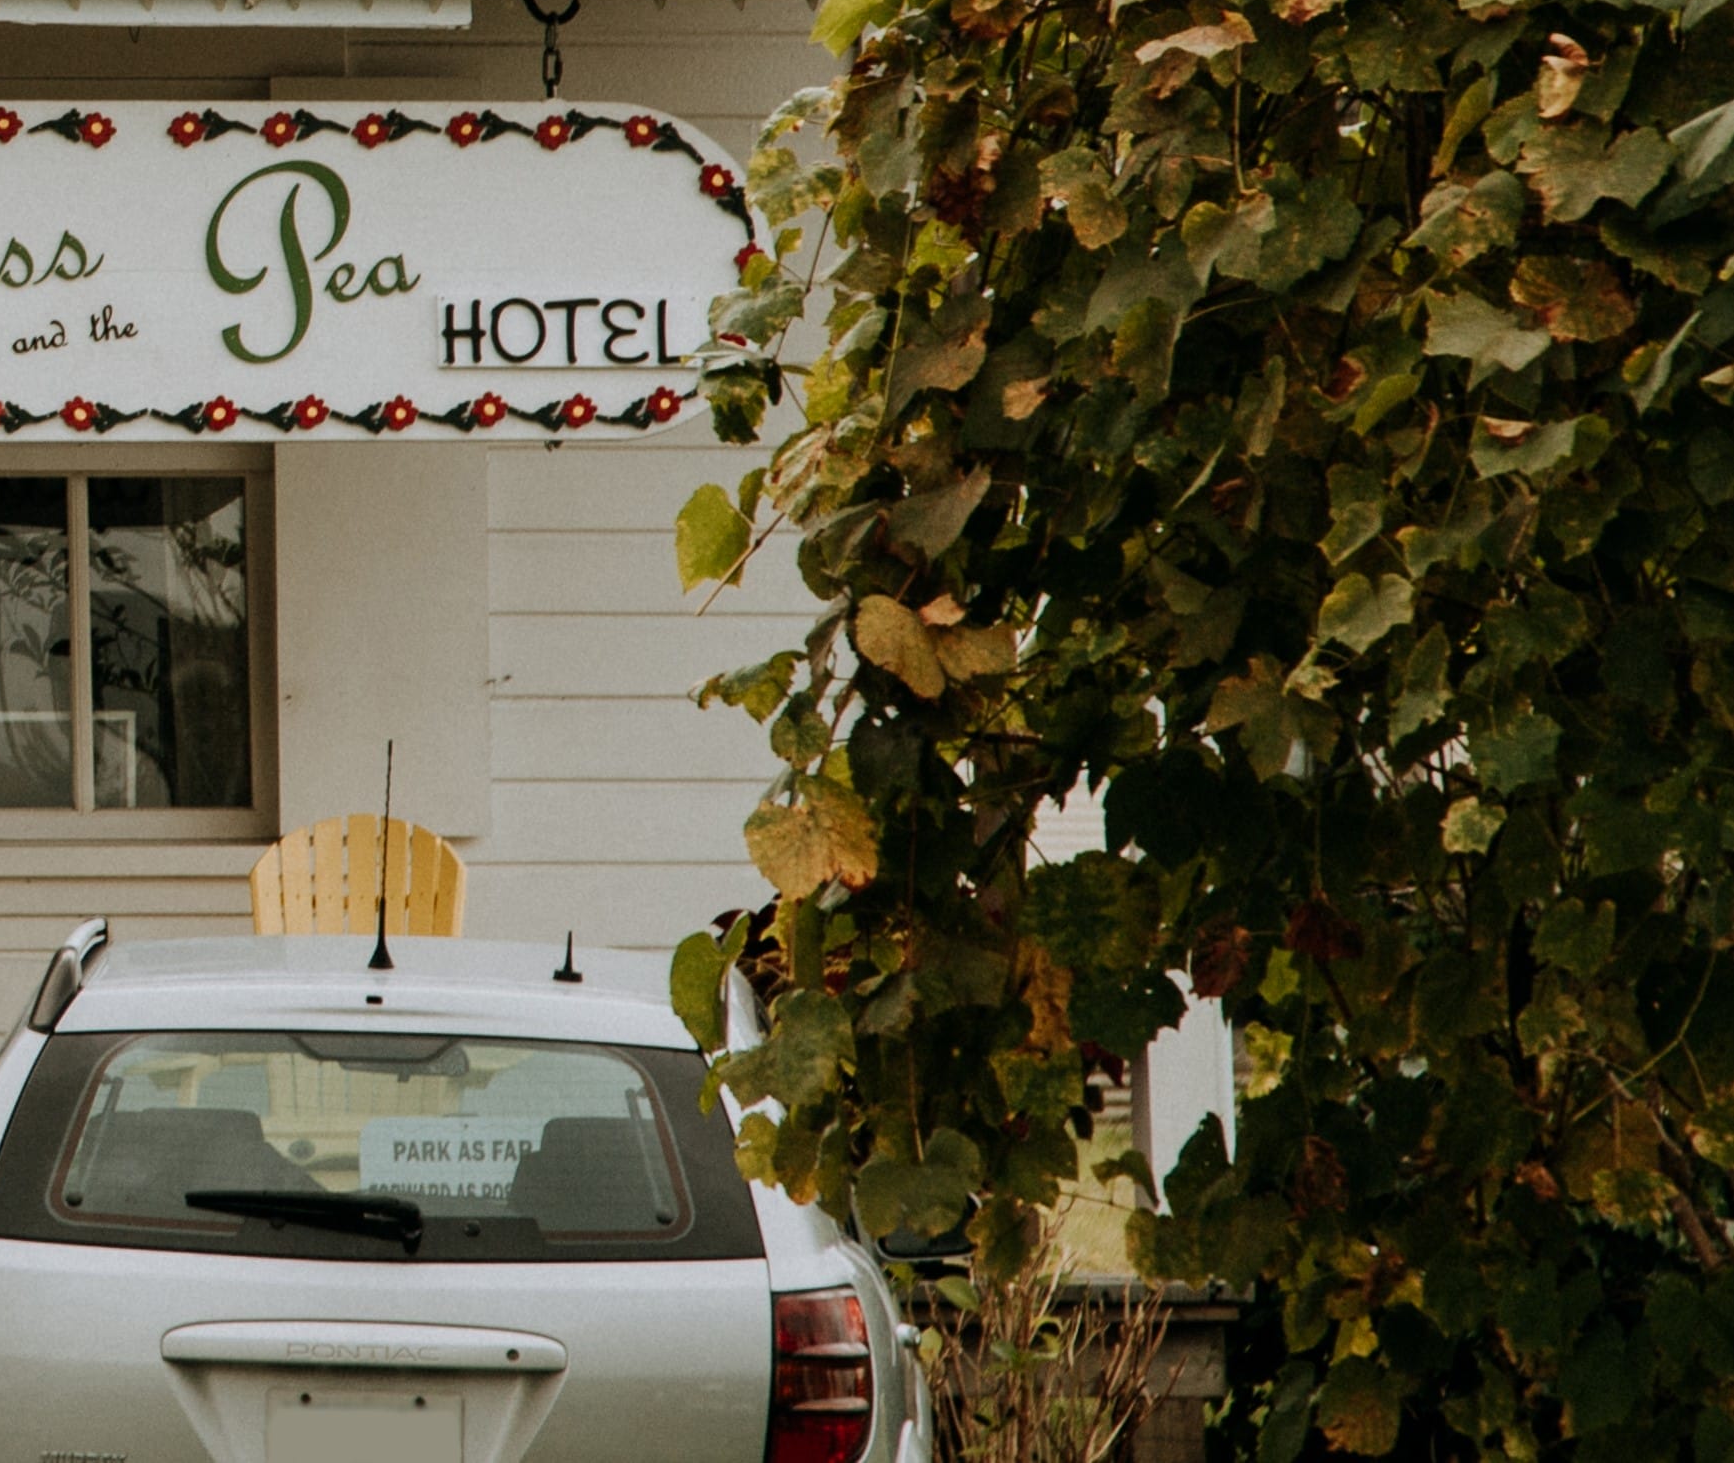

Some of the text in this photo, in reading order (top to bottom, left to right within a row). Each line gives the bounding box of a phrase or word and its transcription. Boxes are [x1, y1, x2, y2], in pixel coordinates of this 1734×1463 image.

[11, 320, 68, 354] and
[89, 305, 139, 343] the
[205, 159, 421, 364] Pea
[441, 297, 683, 365] HOTEL
[392, 1140, 451, 1162] PARK
[458, 1140, 486, 1162] AS
[285, 1342, 440, 1362] PONTIAC
